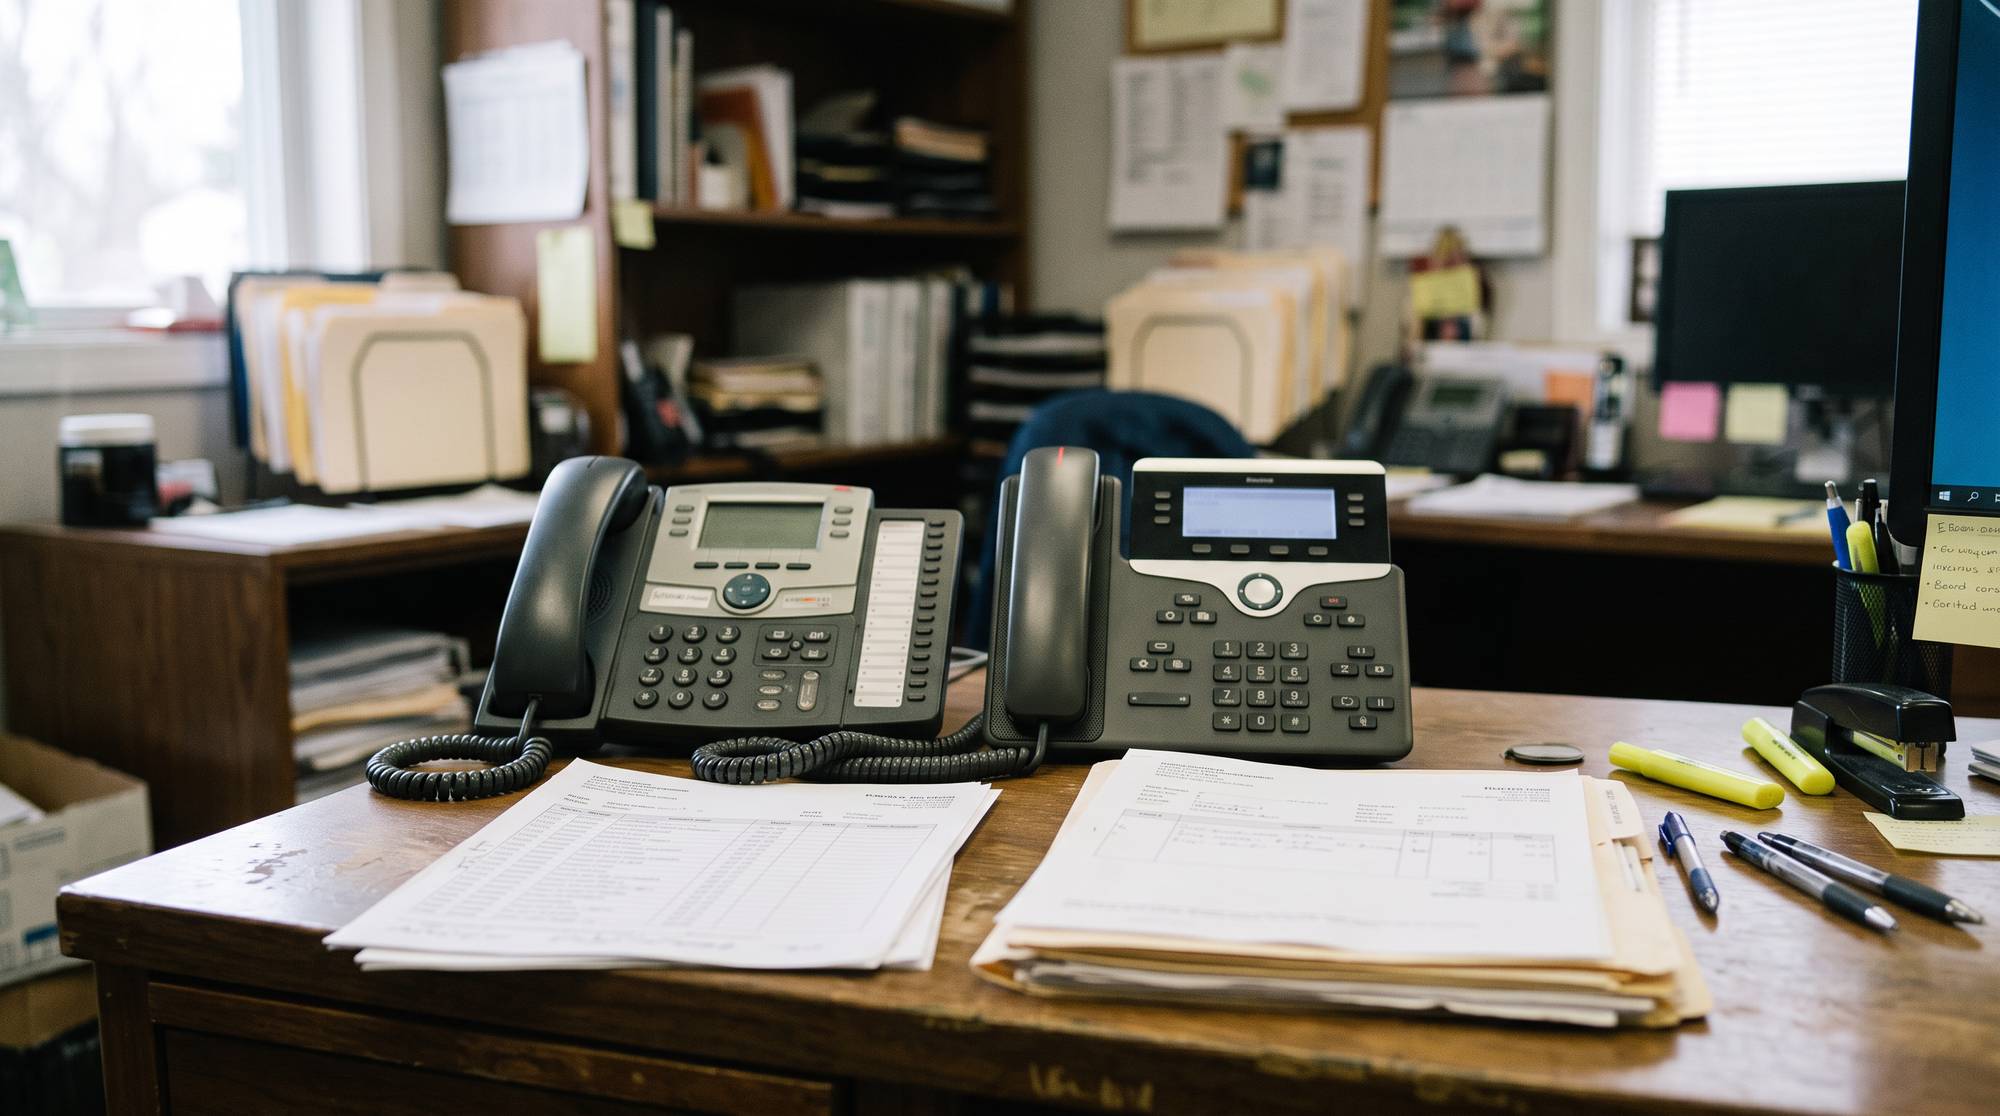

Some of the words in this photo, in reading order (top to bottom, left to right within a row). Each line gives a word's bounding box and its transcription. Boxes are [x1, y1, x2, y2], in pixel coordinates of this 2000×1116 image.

[691, 627, 698, 635] 2
[1225, 642, 1229, 651] 1
[1257, 643, 1264, 651] 2
[1290, 643, 1298, 652] 3
[648, 669, 655, 677] 7
[681, 669, 689, 677] 8
[716, 670, 723, 678] 9
[1224, 666, 1231, 674] 4
[1257, 666, 1264, 675] 5
[1291, 667, 1298, 676] 6
[1224, 690, 1231, 699] 7
[1257, 690, 1265, 699] 8
[1291, 691, 1298, 700] 9
[1257, 716, 1265, 725] 0
